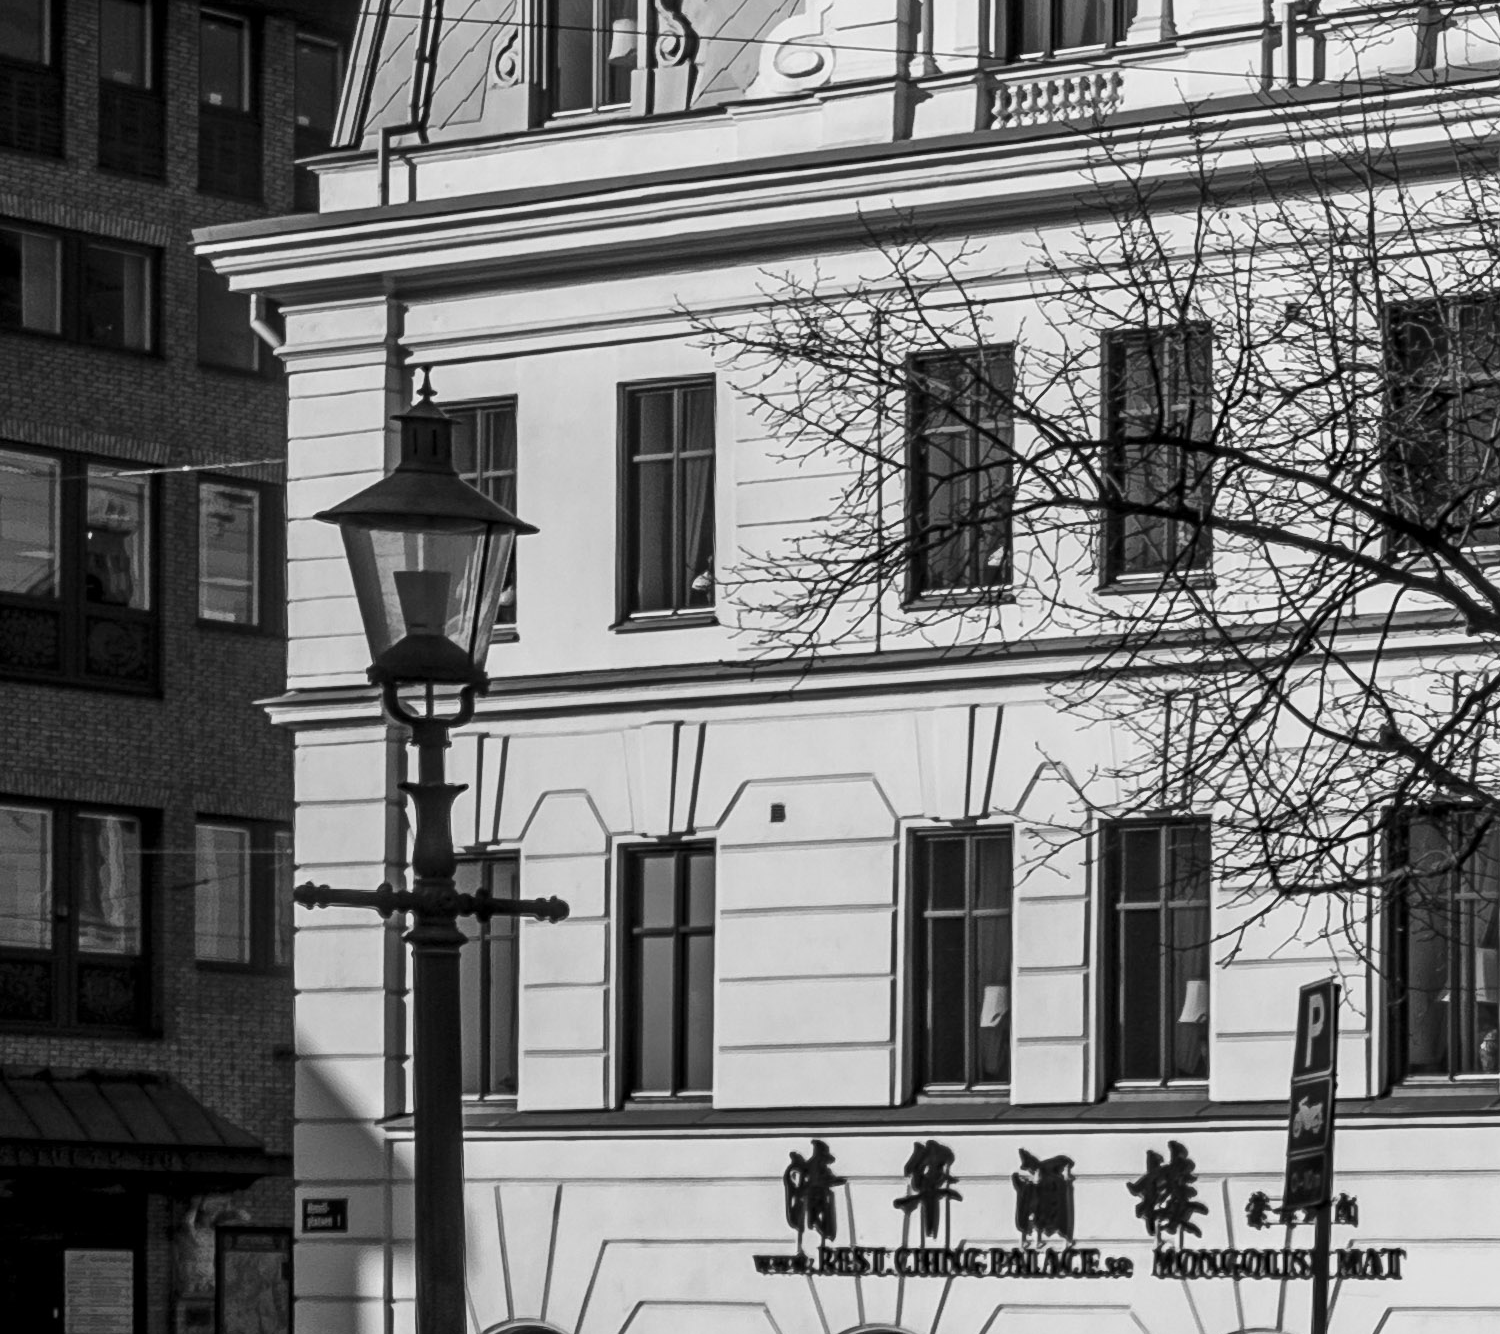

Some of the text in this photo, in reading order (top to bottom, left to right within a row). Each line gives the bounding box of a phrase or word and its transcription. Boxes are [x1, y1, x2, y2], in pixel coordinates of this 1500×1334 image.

[1304, 993, 1325, 1068] P
[1152, 1247, 1407, 1280] MONGOLIS MAT
